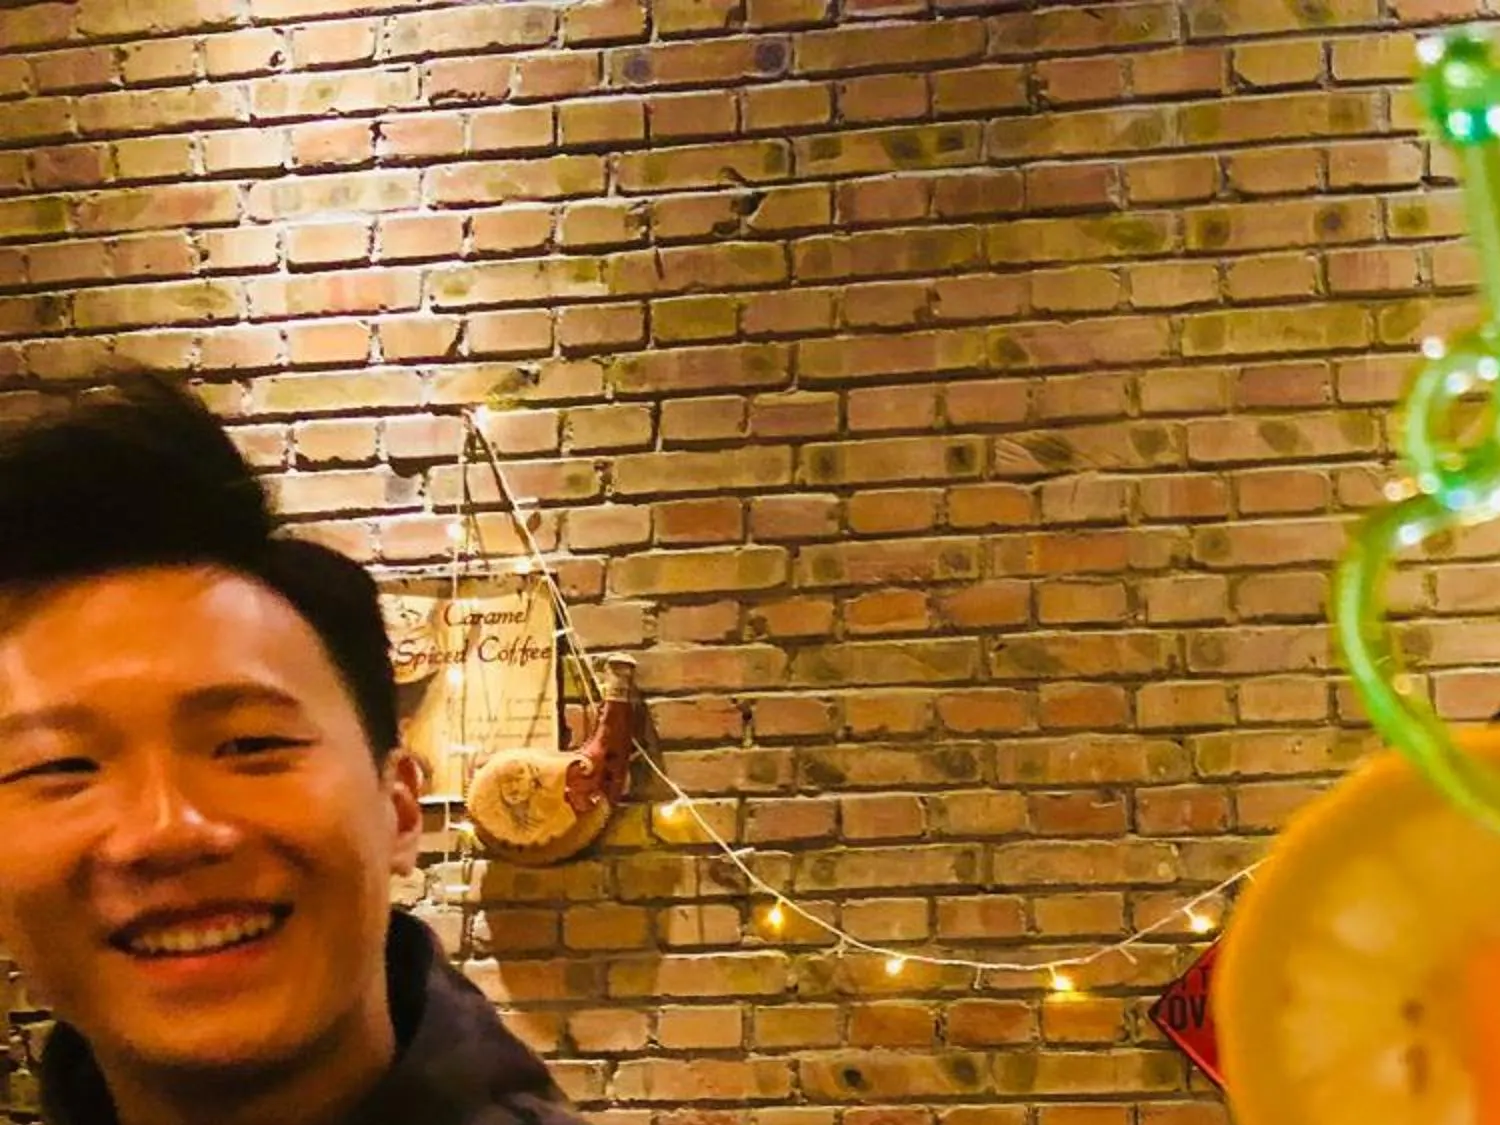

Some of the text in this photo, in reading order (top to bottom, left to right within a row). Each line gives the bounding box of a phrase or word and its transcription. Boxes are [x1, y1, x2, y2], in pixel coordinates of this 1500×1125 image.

[445, 602, 529, 626] Caramel
[396, 636, 552, 669] Spiced Coffee
